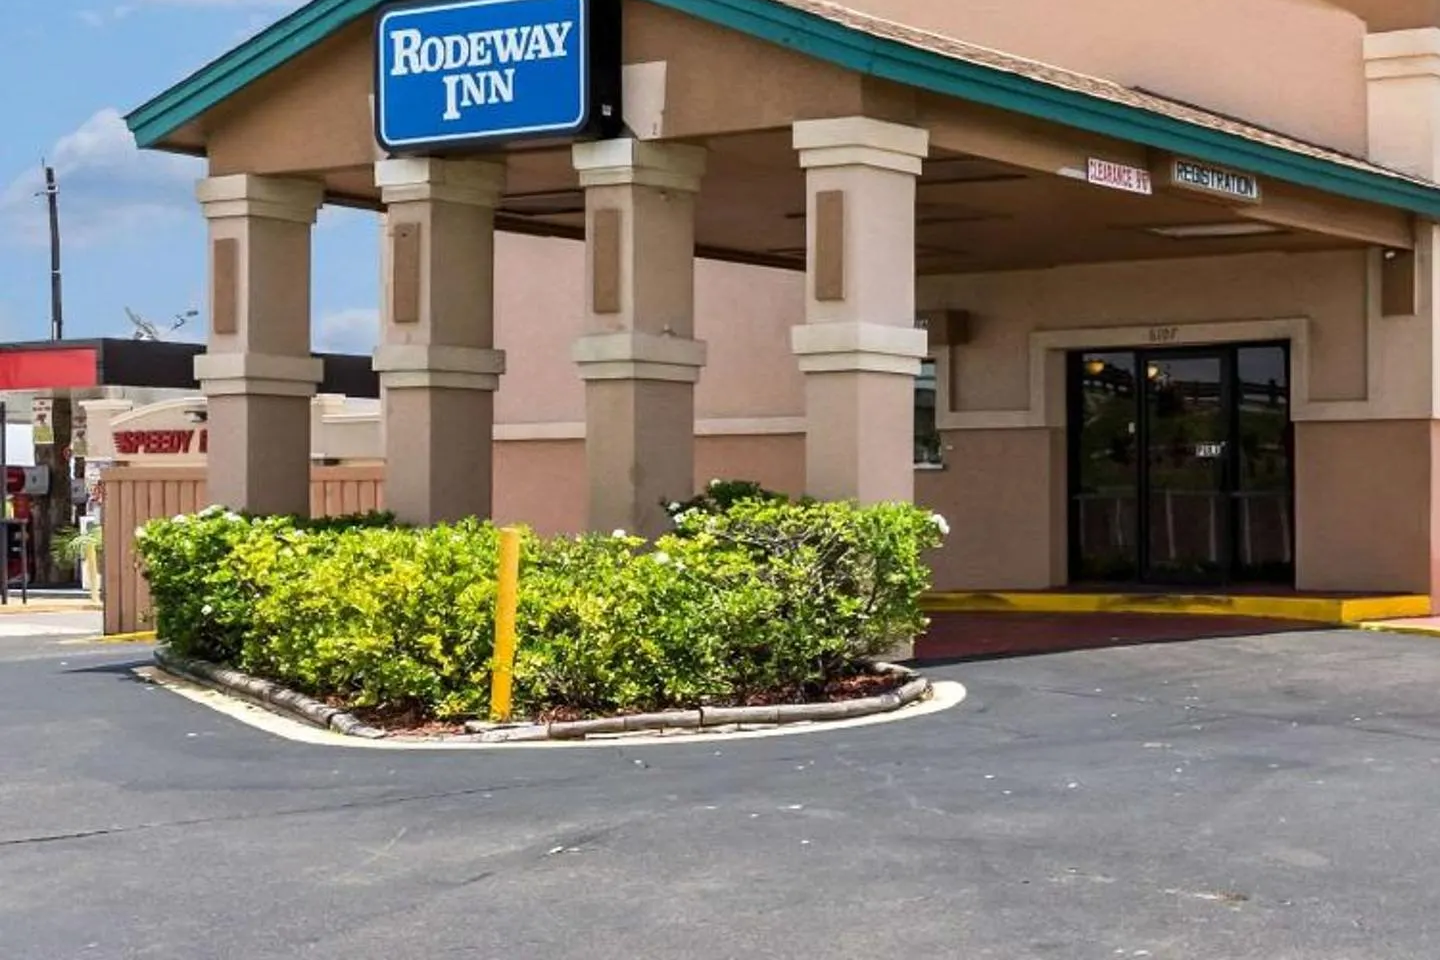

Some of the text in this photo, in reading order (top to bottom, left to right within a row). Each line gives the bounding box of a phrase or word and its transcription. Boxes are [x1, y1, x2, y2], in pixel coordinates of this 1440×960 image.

[389, 21, 573, 76] RODEWAY
[442, 68, 516, 121] INN
[1177, 161, 1254, 197] REGISTRATION
[112, 429, 195, 454] SPEEDY
